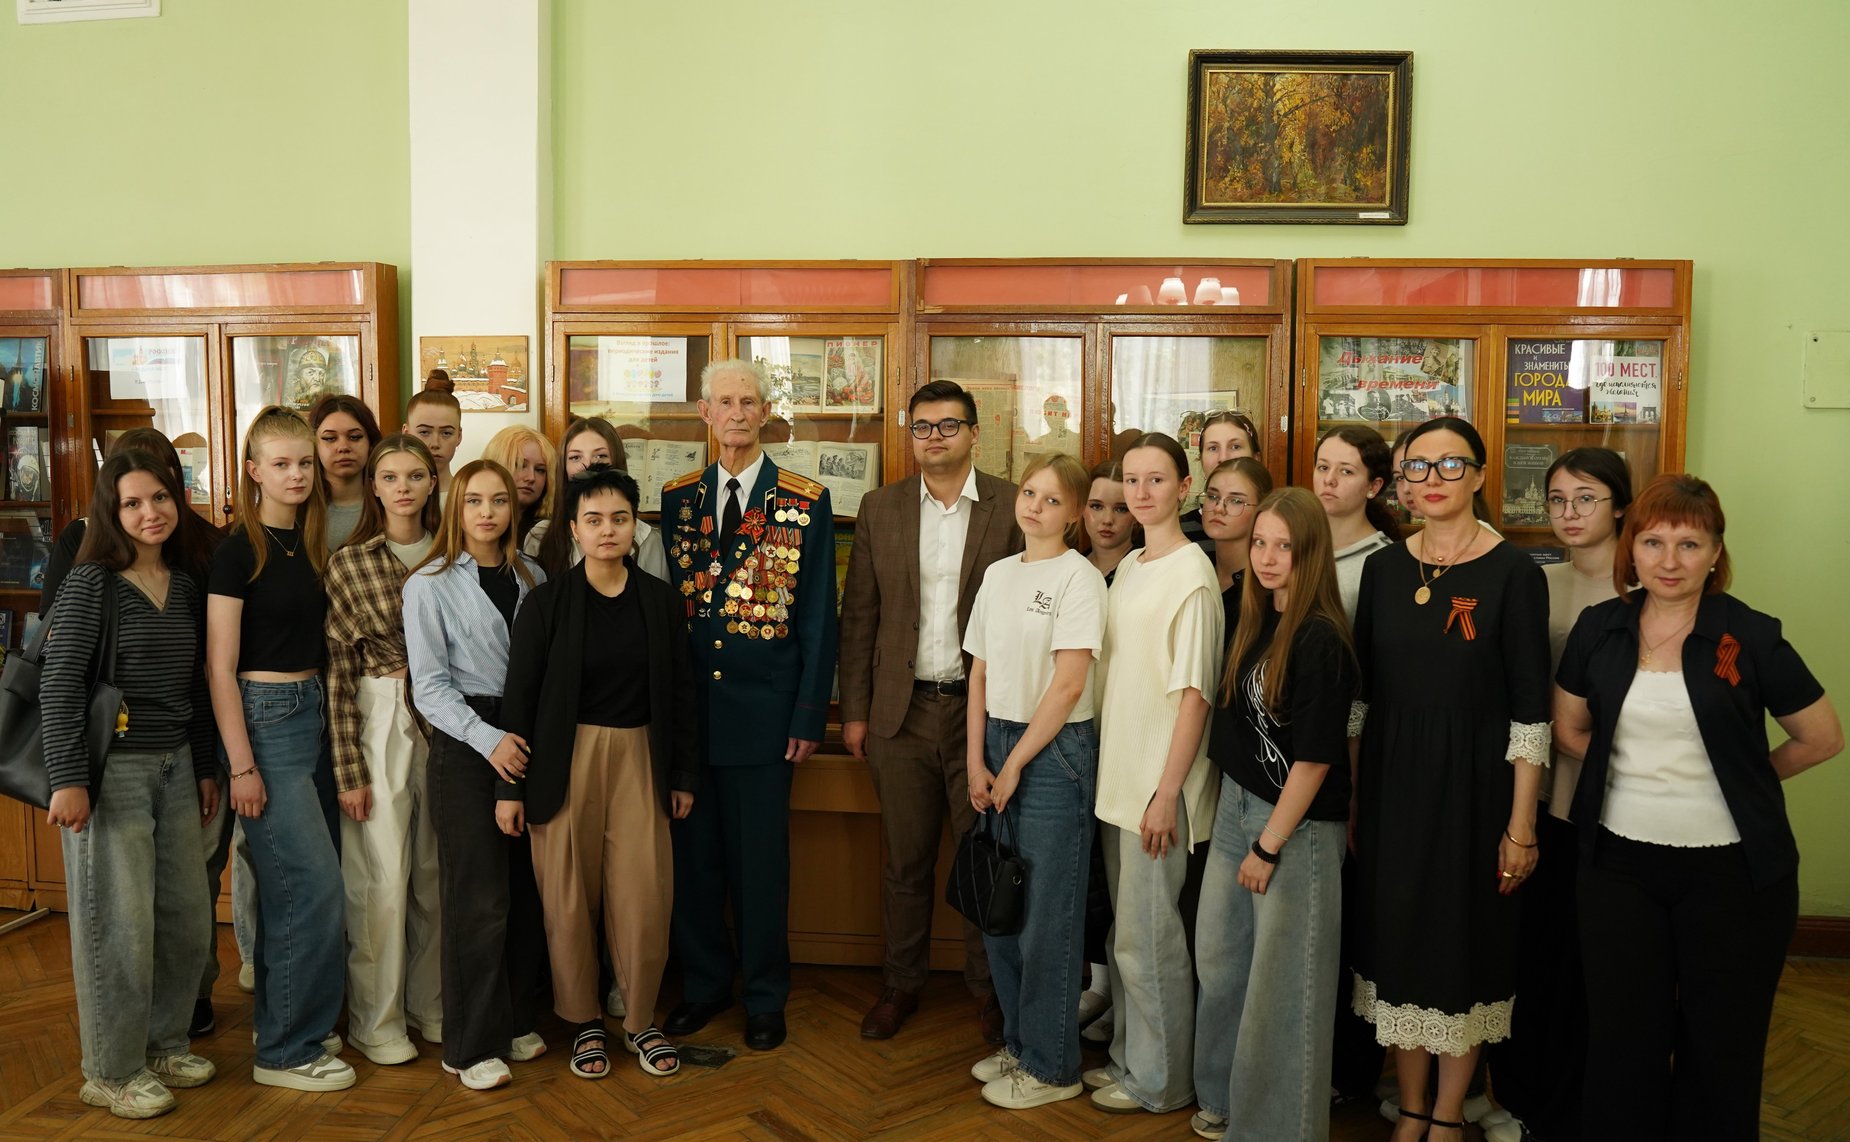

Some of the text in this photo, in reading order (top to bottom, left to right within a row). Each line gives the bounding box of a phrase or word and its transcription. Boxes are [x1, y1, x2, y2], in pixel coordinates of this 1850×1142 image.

[827, 340, 878, 348] ПИОНЕР
[1514, 343, 1566, 355] КРАСИВЫЕ
[1336, 350, 1424, 366] Дыхание
[1524, 361, 1570, 371] ЗНАМЕНИТЫ
[1595, 362, 1615, 377] 100
[1356, 378, 1440, 391] времени
[1514, 372, 1569, 389] ГОРОД
[1523, 389, 1563, 407] МИРА
